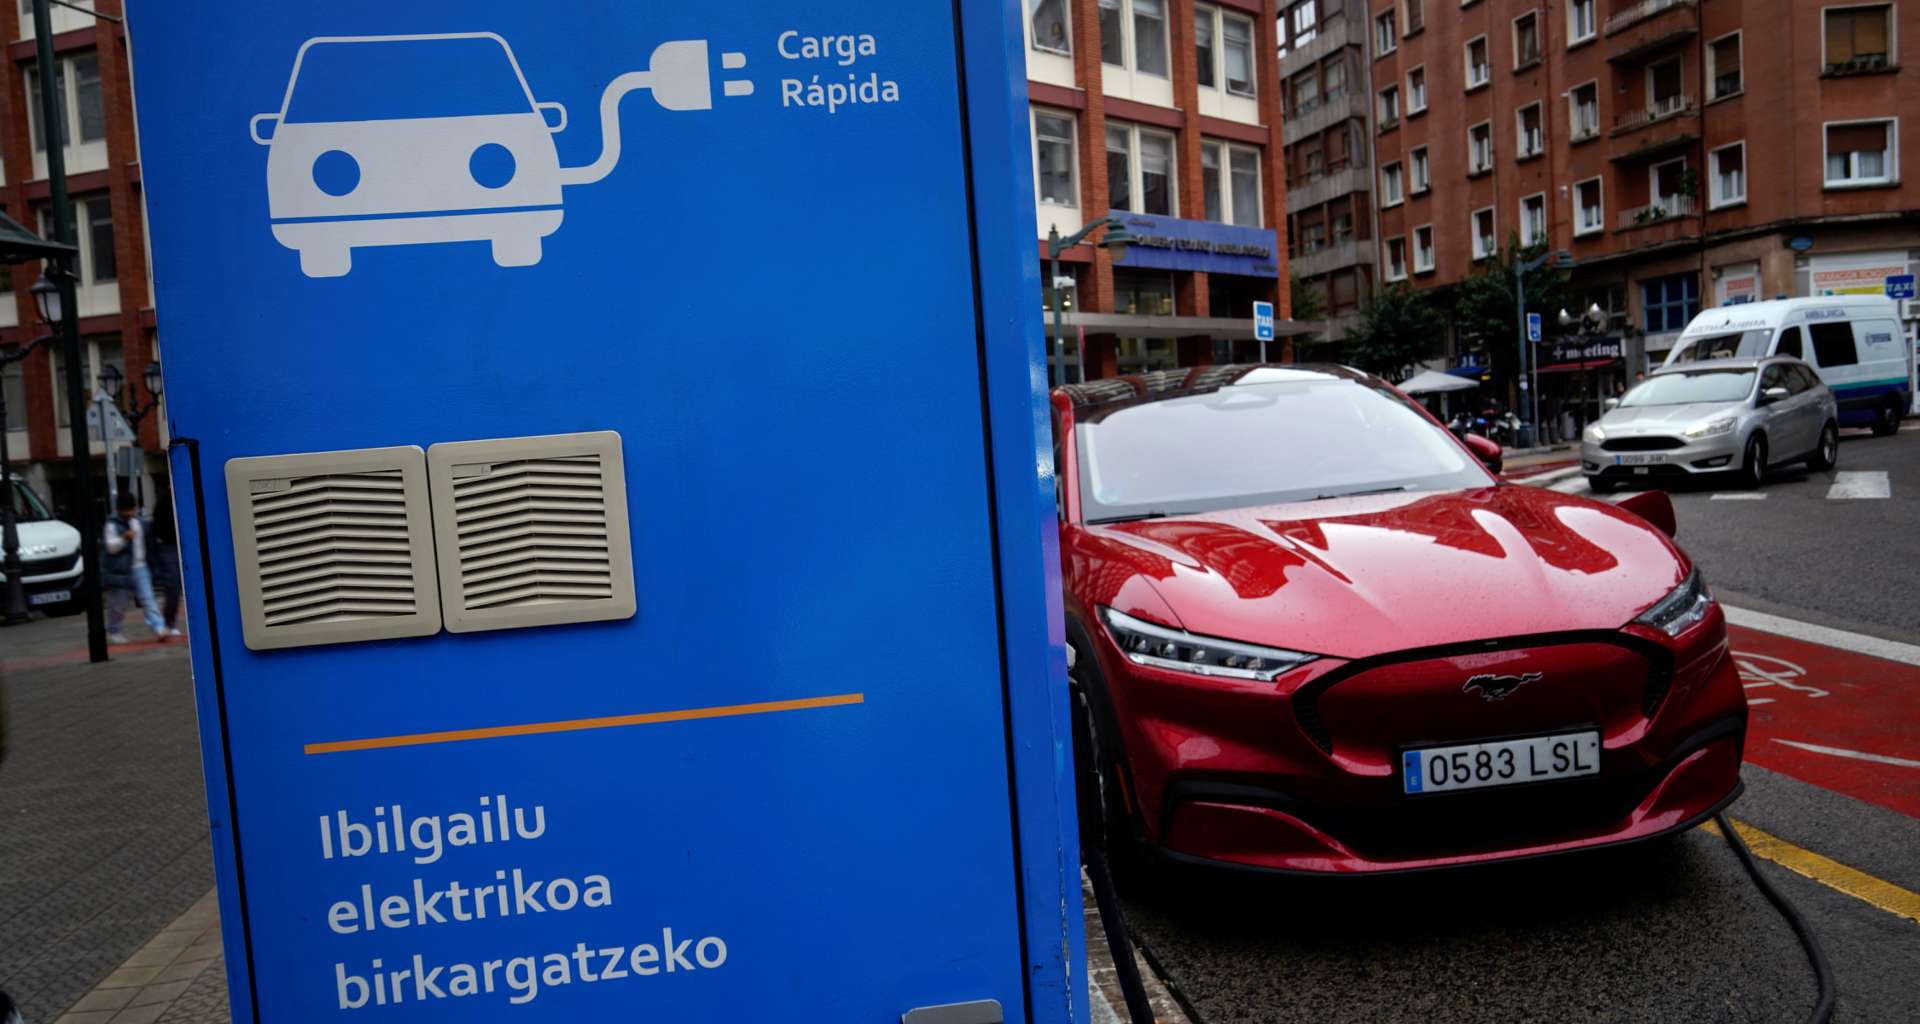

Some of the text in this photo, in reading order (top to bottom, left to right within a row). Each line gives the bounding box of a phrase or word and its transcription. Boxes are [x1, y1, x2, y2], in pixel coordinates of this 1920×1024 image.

[777, 29, 877, 66] Carga
[781, 72, 900, 114] Rápida
[1887, 282, 1914, 294] TAXI
[1429, 748, 1515, 786] 0583
[1529, 740, 1592, 776] LSL
[319, 794, 547, 865] Ibilgailu
[327, 868, 613, 935] elektrikoa
[335, 927, 728, 1010] birkargatzeko
